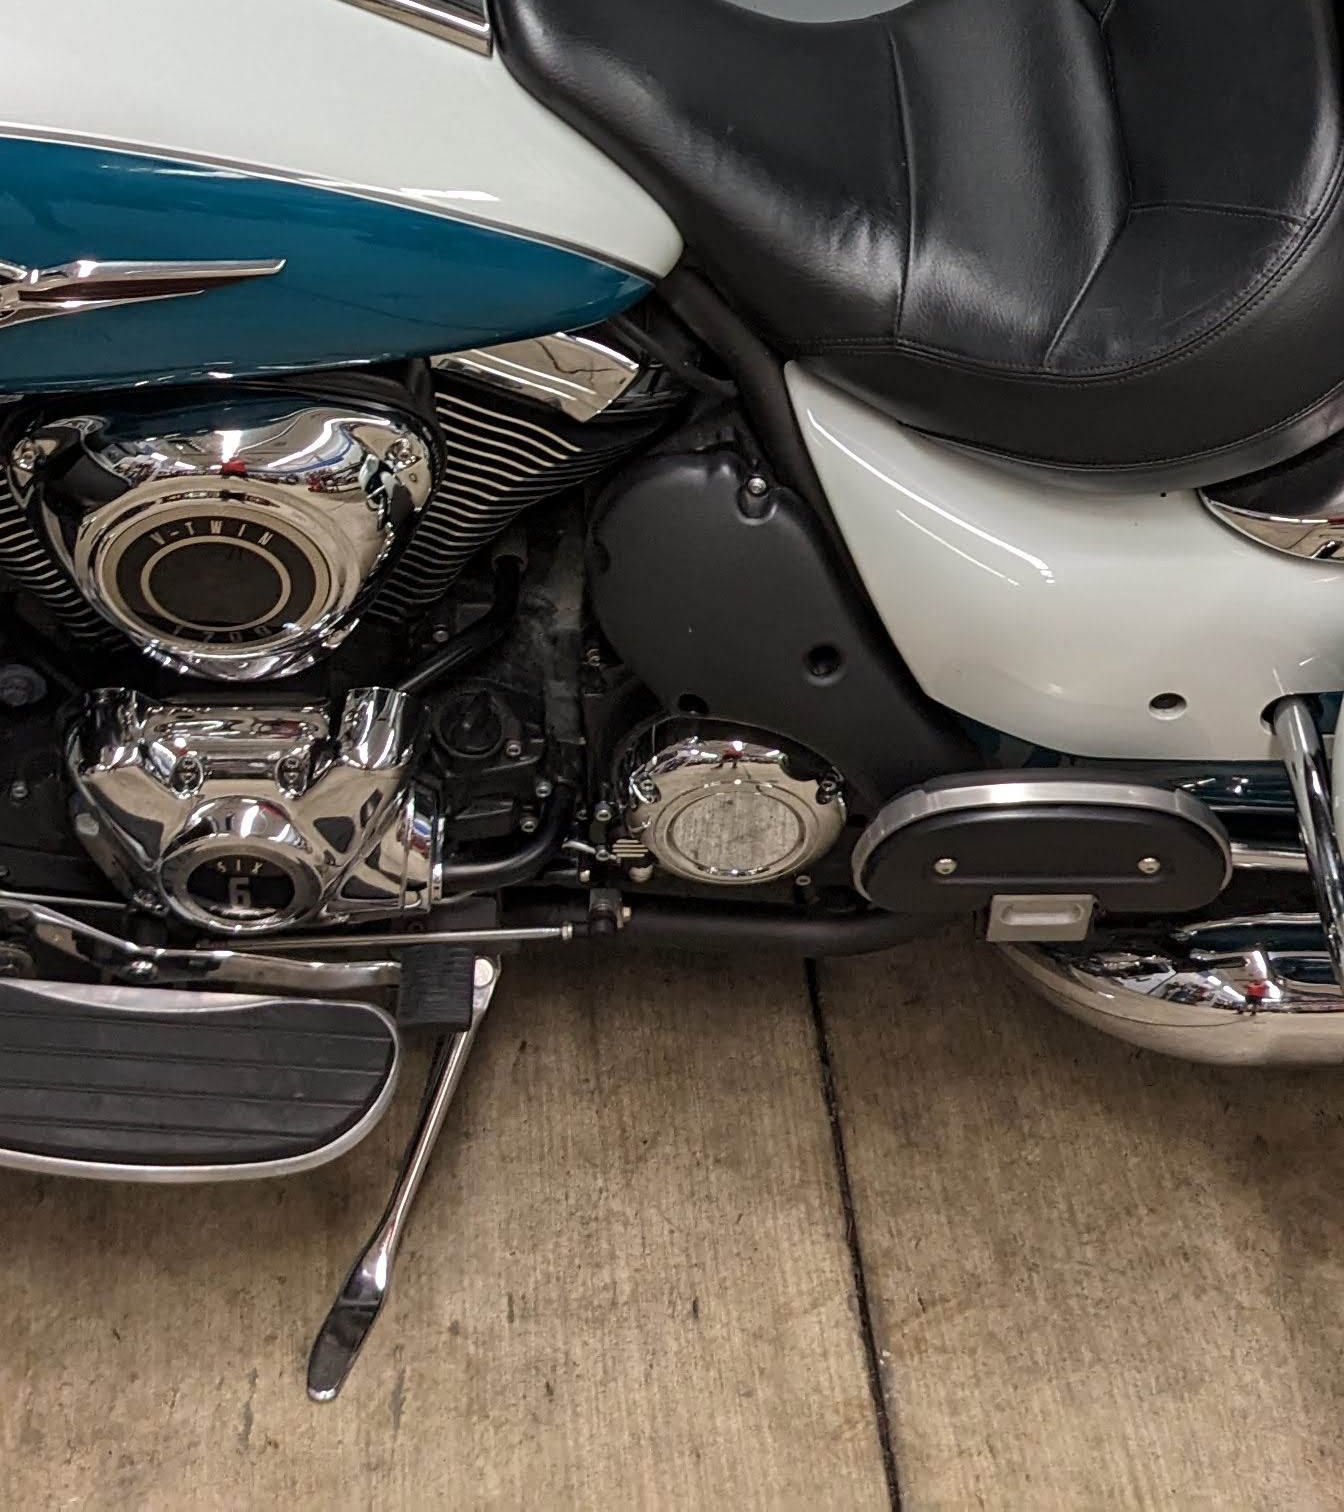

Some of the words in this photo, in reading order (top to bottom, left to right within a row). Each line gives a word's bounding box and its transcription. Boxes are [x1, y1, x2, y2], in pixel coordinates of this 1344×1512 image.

[150, 520, 275, 546] V-TWIN
[217, 859, 263, 875] SIX
[228, 877, 252, 908] 6
